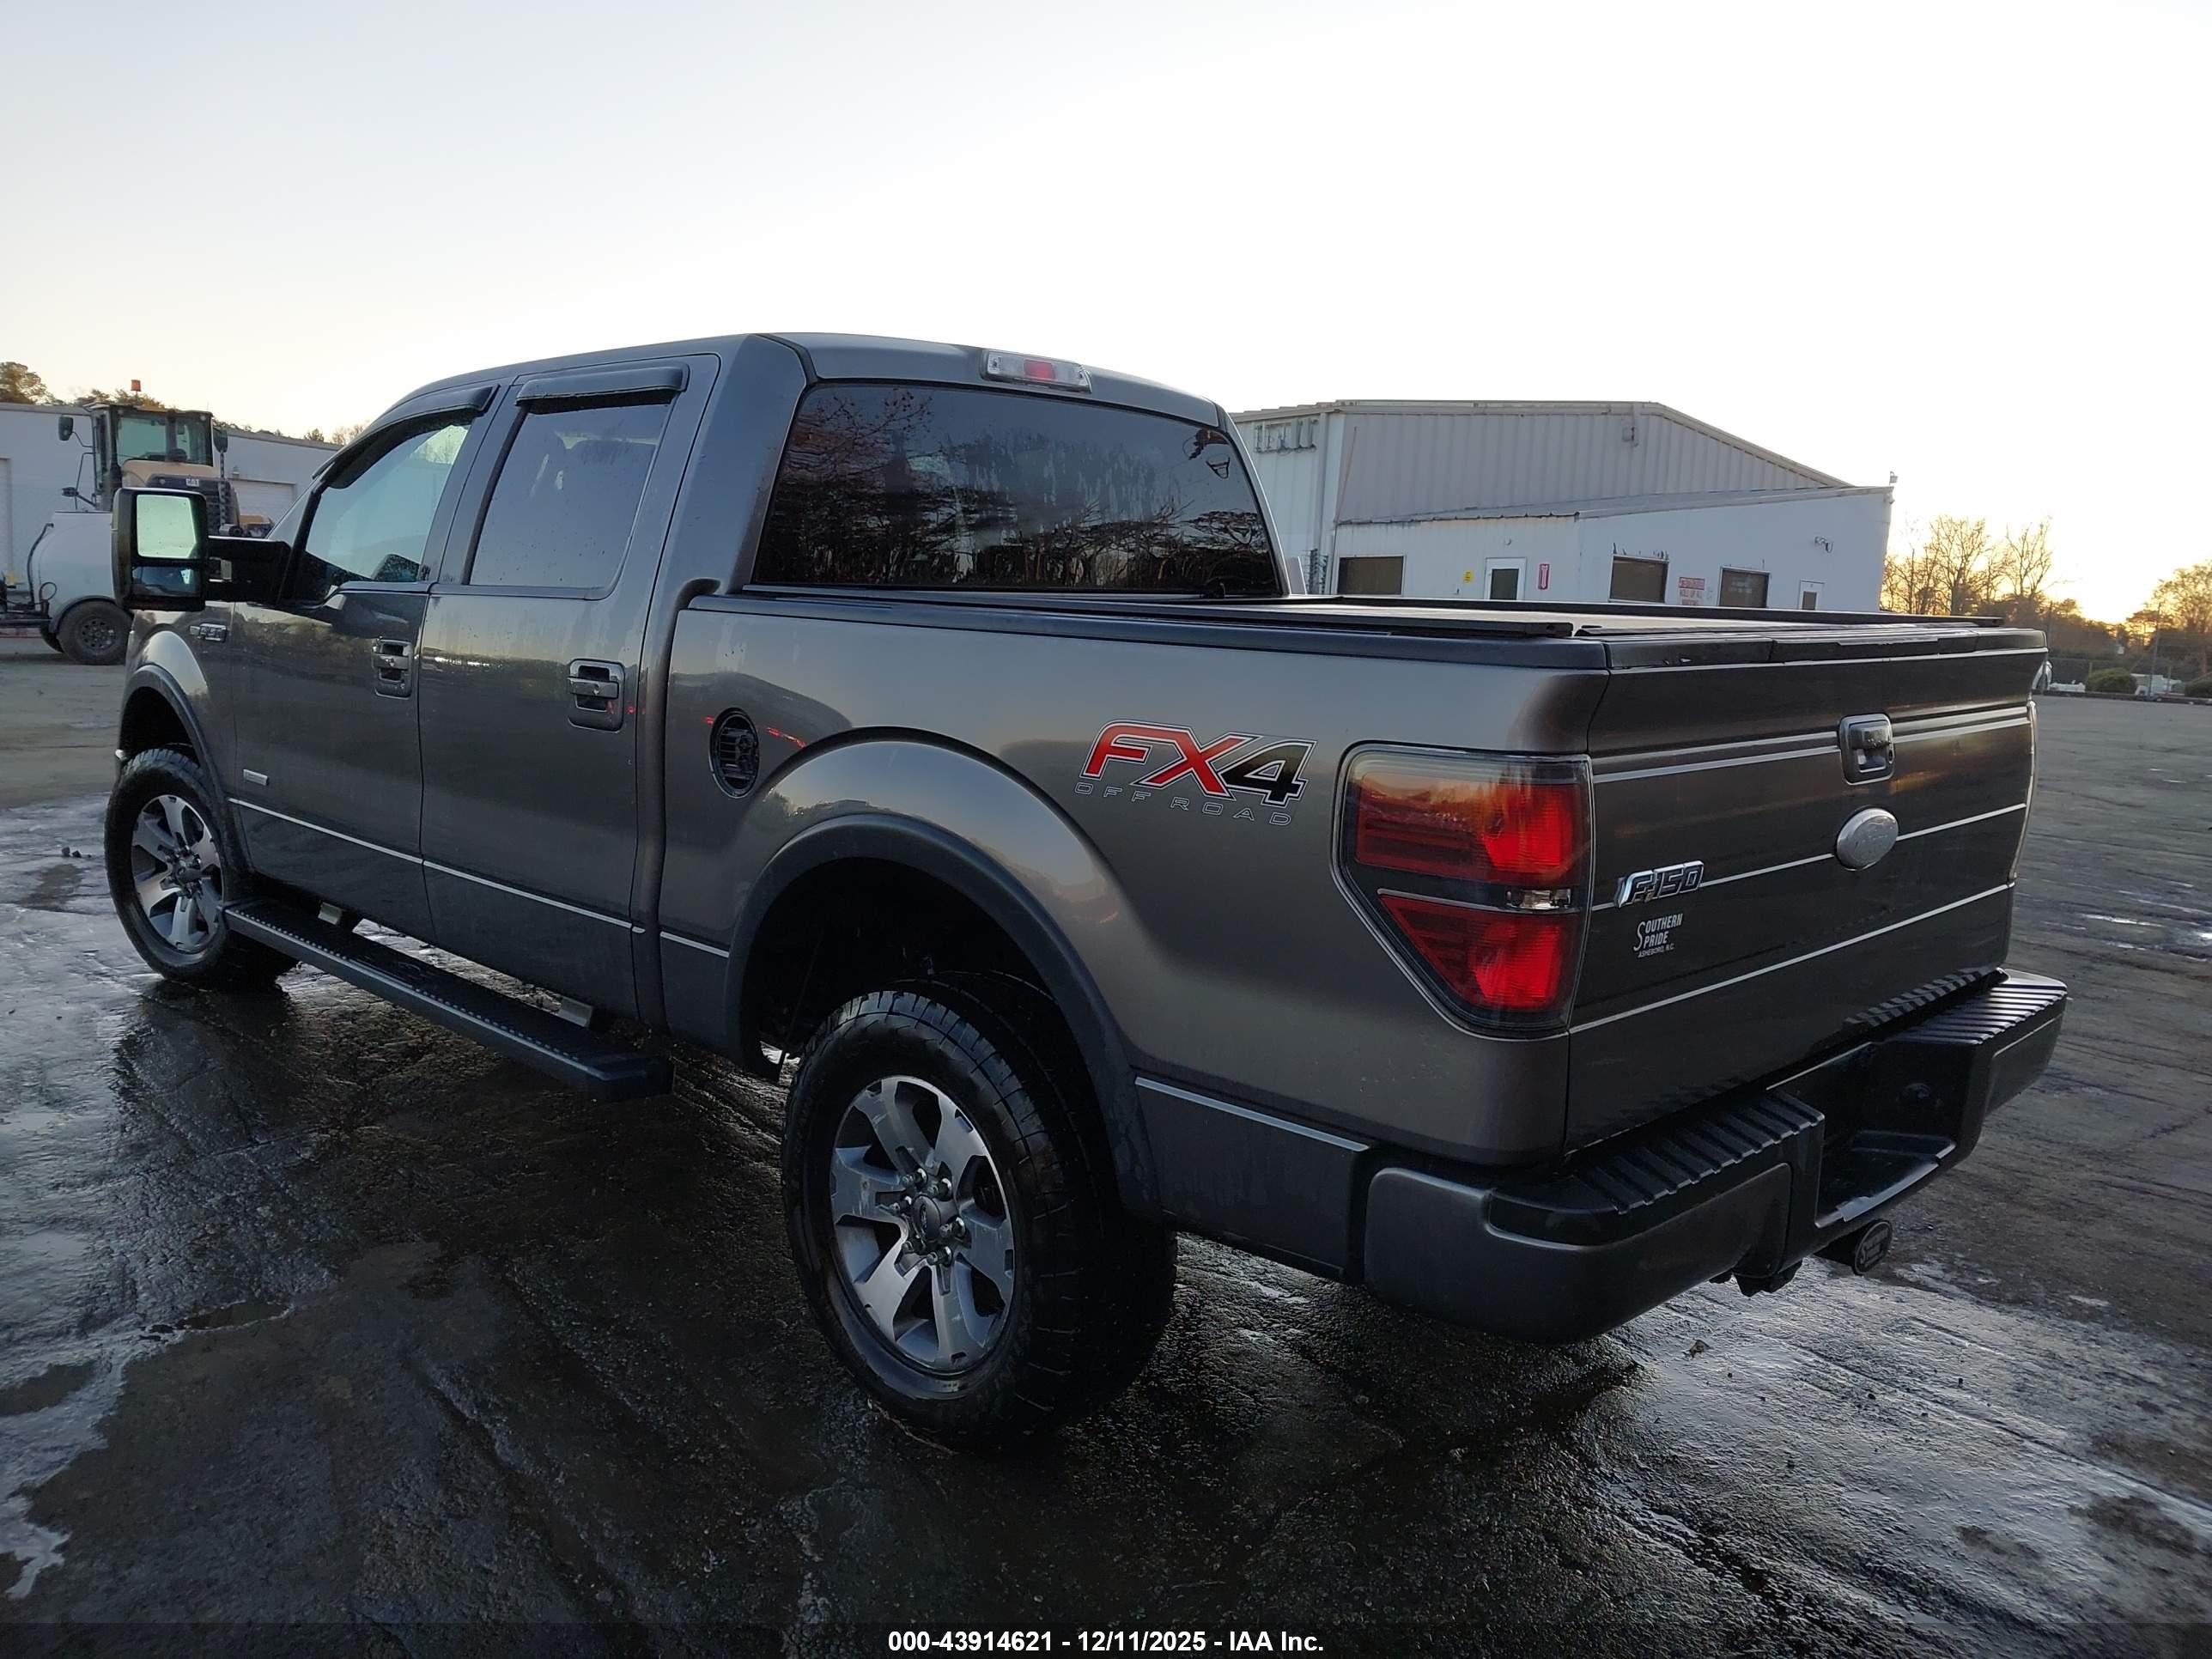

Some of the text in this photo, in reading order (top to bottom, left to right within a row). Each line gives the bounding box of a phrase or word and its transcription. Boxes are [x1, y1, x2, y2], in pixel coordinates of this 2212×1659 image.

[1079, 720, 1318, 808] FX4
[1633, 913, 1684, 951] SOUTHERN
[1643, 931, 1669, 949] PRIDE
